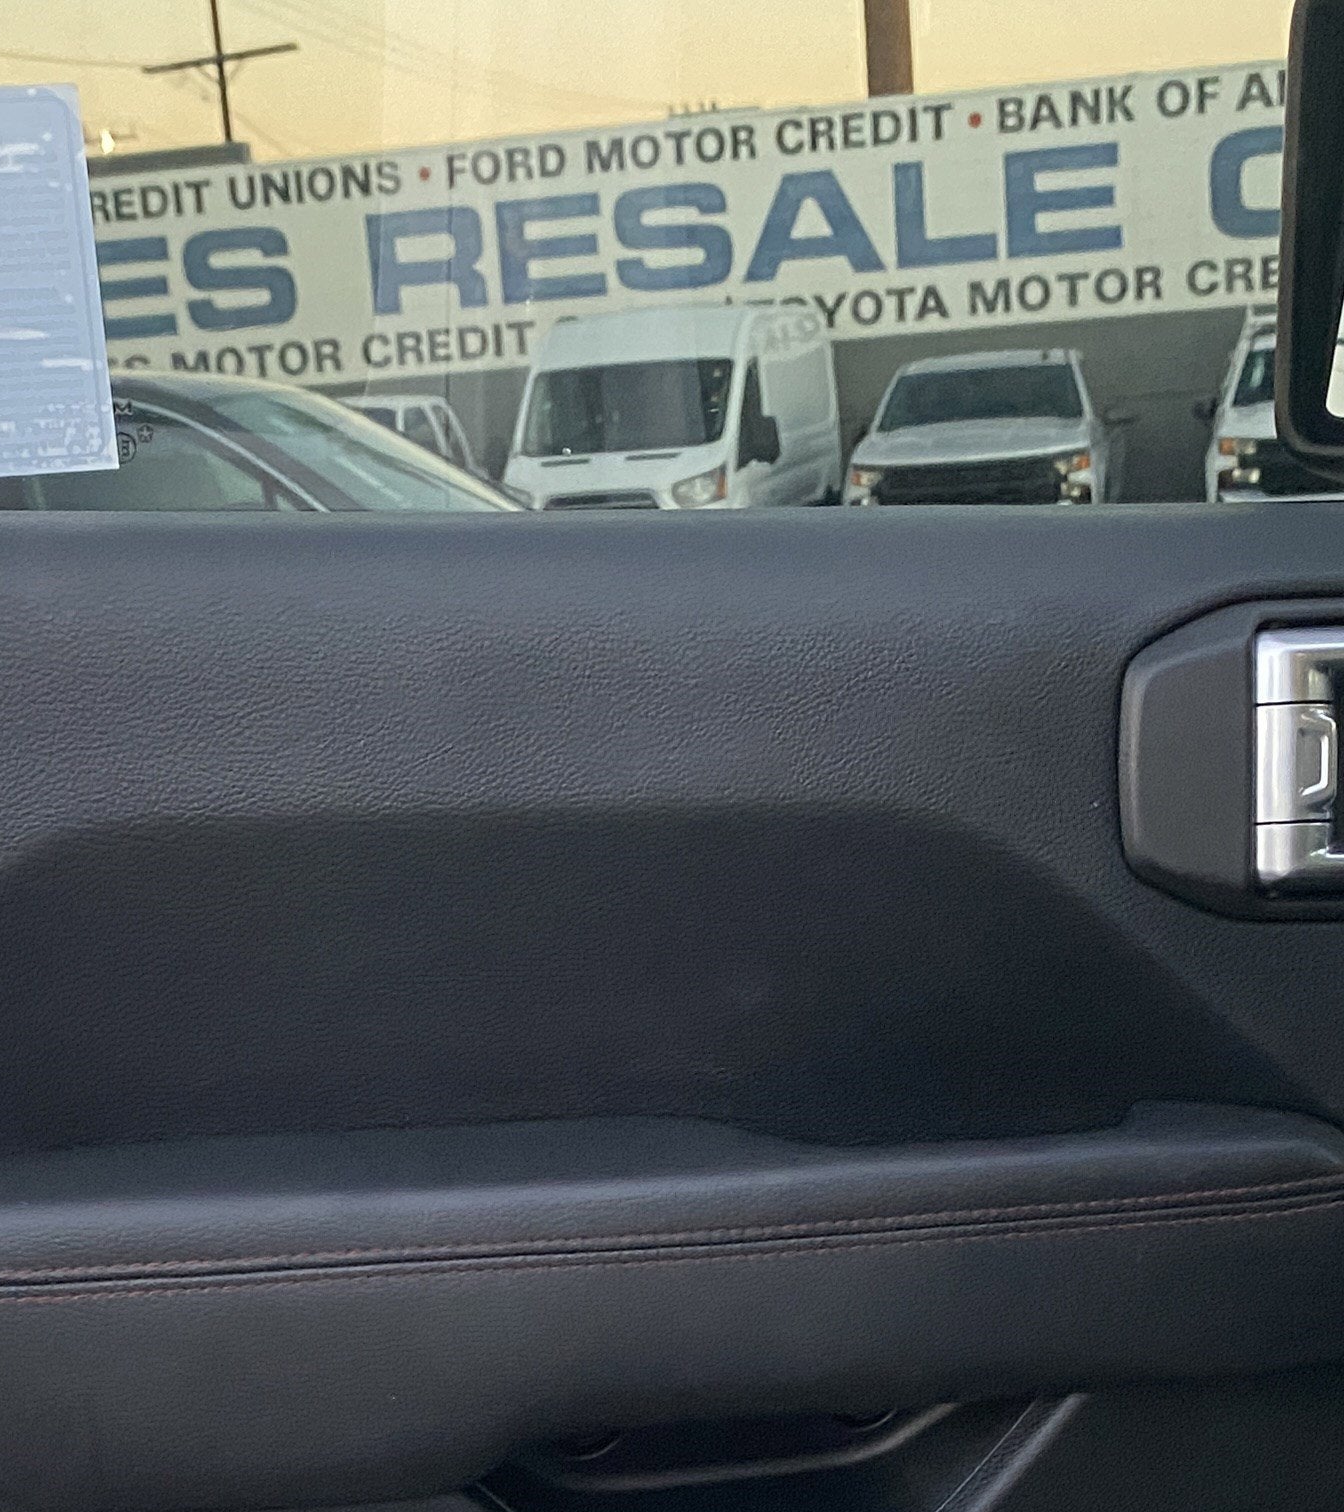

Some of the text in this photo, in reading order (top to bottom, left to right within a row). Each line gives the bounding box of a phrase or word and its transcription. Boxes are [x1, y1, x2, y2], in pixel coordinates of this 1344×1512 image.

[90, 179, 210, 223] REDIT
[228, 161, 402, 210] UNIONS
[446, 144, 565, 190] FORD
[585, 124, 756, 175] MOTOR
[775, 102, 954, 155] CREDIT
[997, 85, 1135, 133] BANK
[1157, 76, 1220, 118] OF
[96, 226, 296, 340] ES
[365, 141, 1124, 316] RESALE
[362, 321, 535, 369] CREDIT
[746, 284, 950, 328] YOTA
[969, 266, 1163, 315] MOTOR
